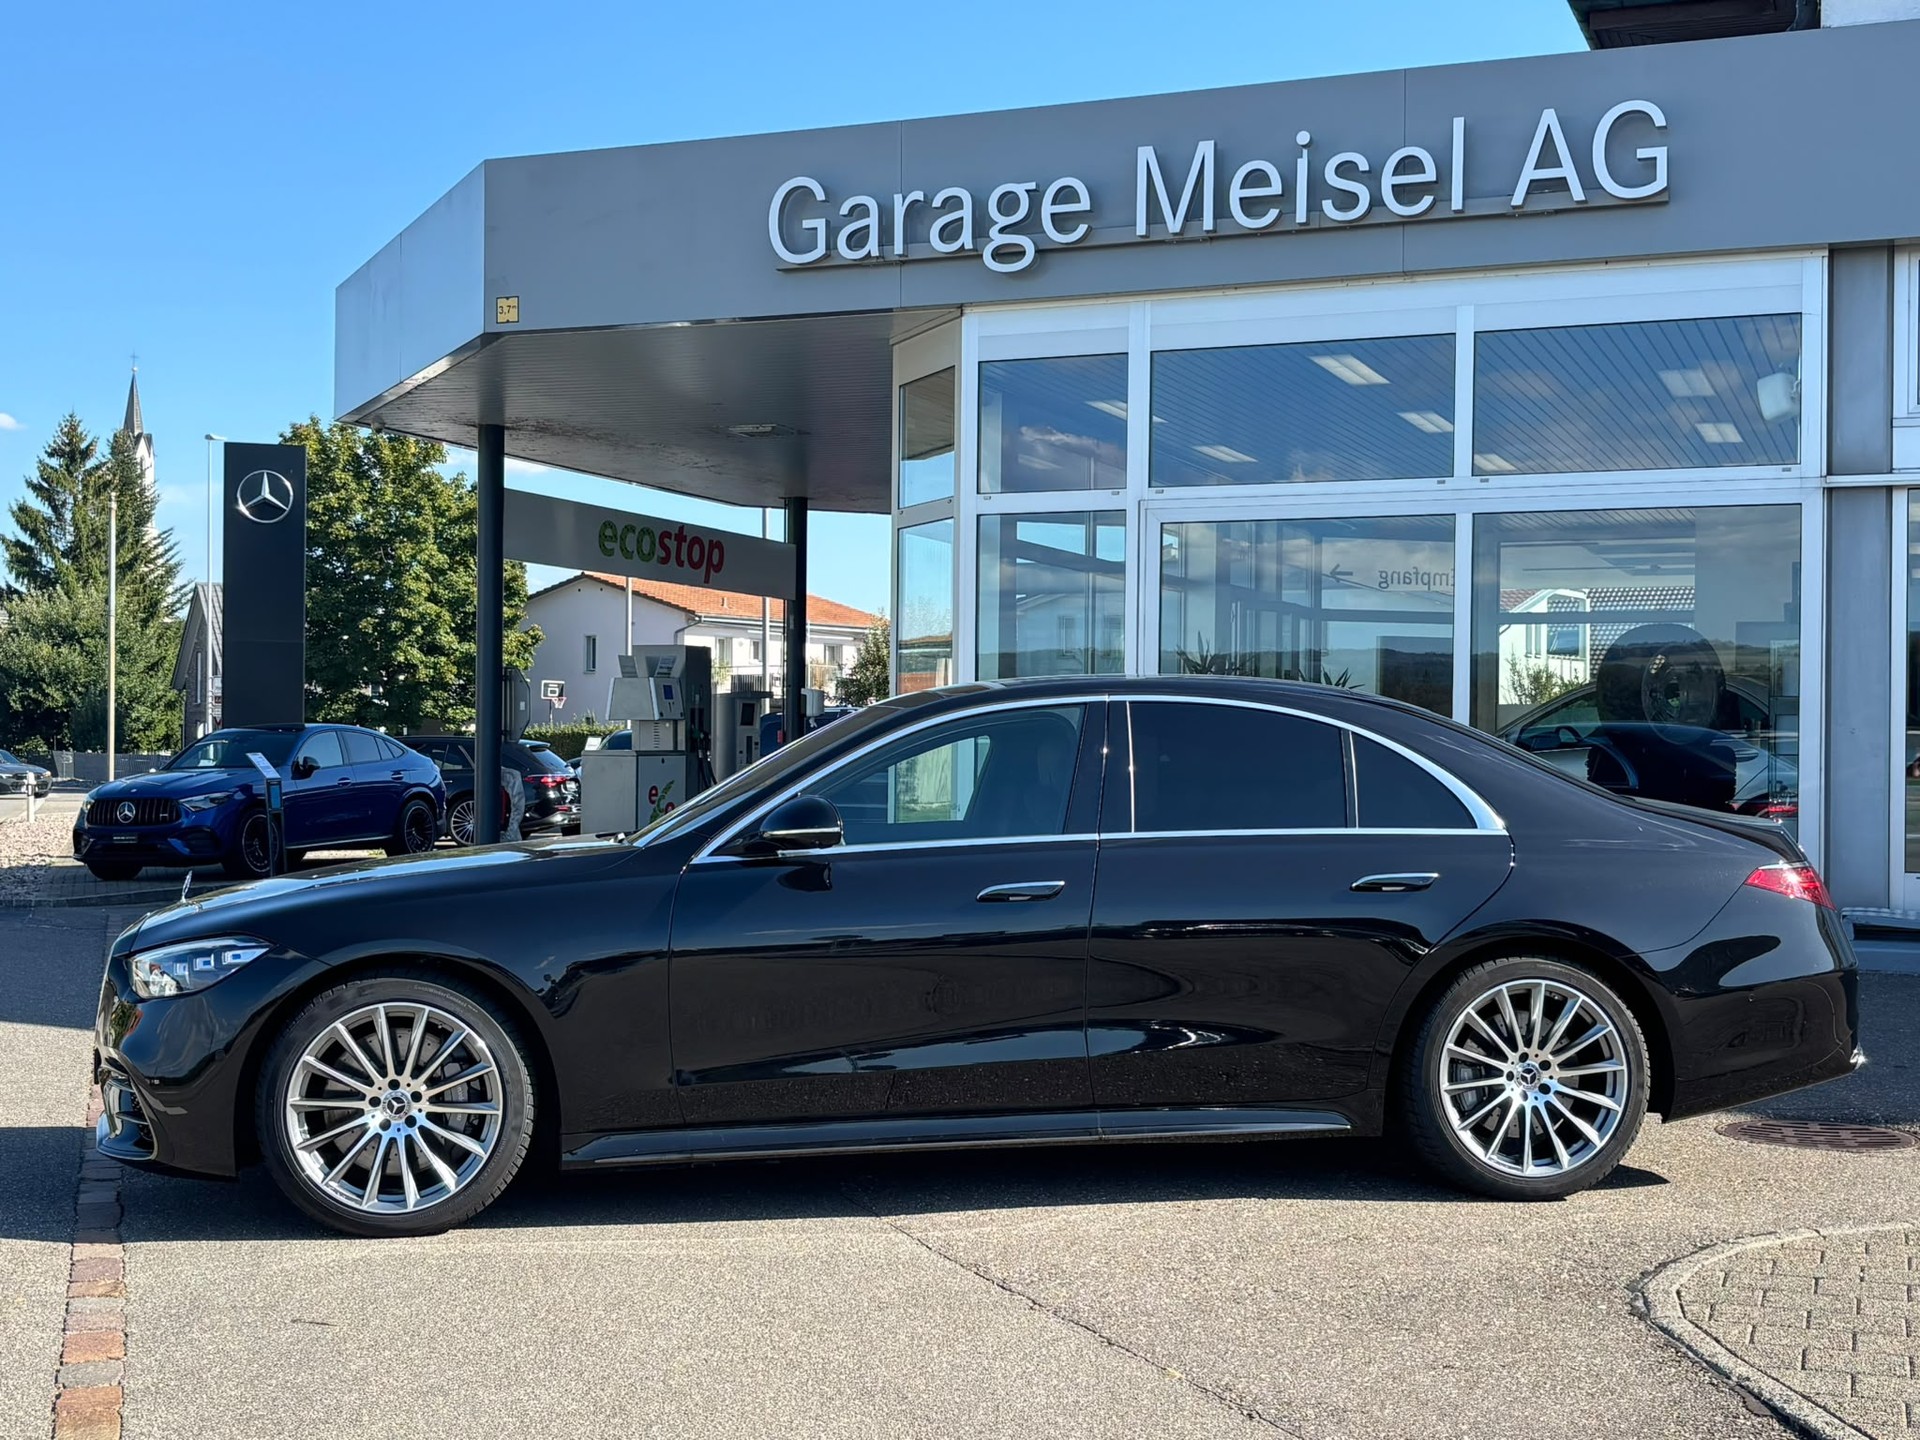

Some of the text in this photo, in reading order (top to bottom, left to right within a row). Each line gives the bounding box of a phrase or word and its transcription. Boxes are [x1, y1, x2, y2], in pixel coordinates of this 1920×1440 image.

[768, 99, 1669, 273] Garage Meisel AG
[598, 519, 725, 585] ecostop
